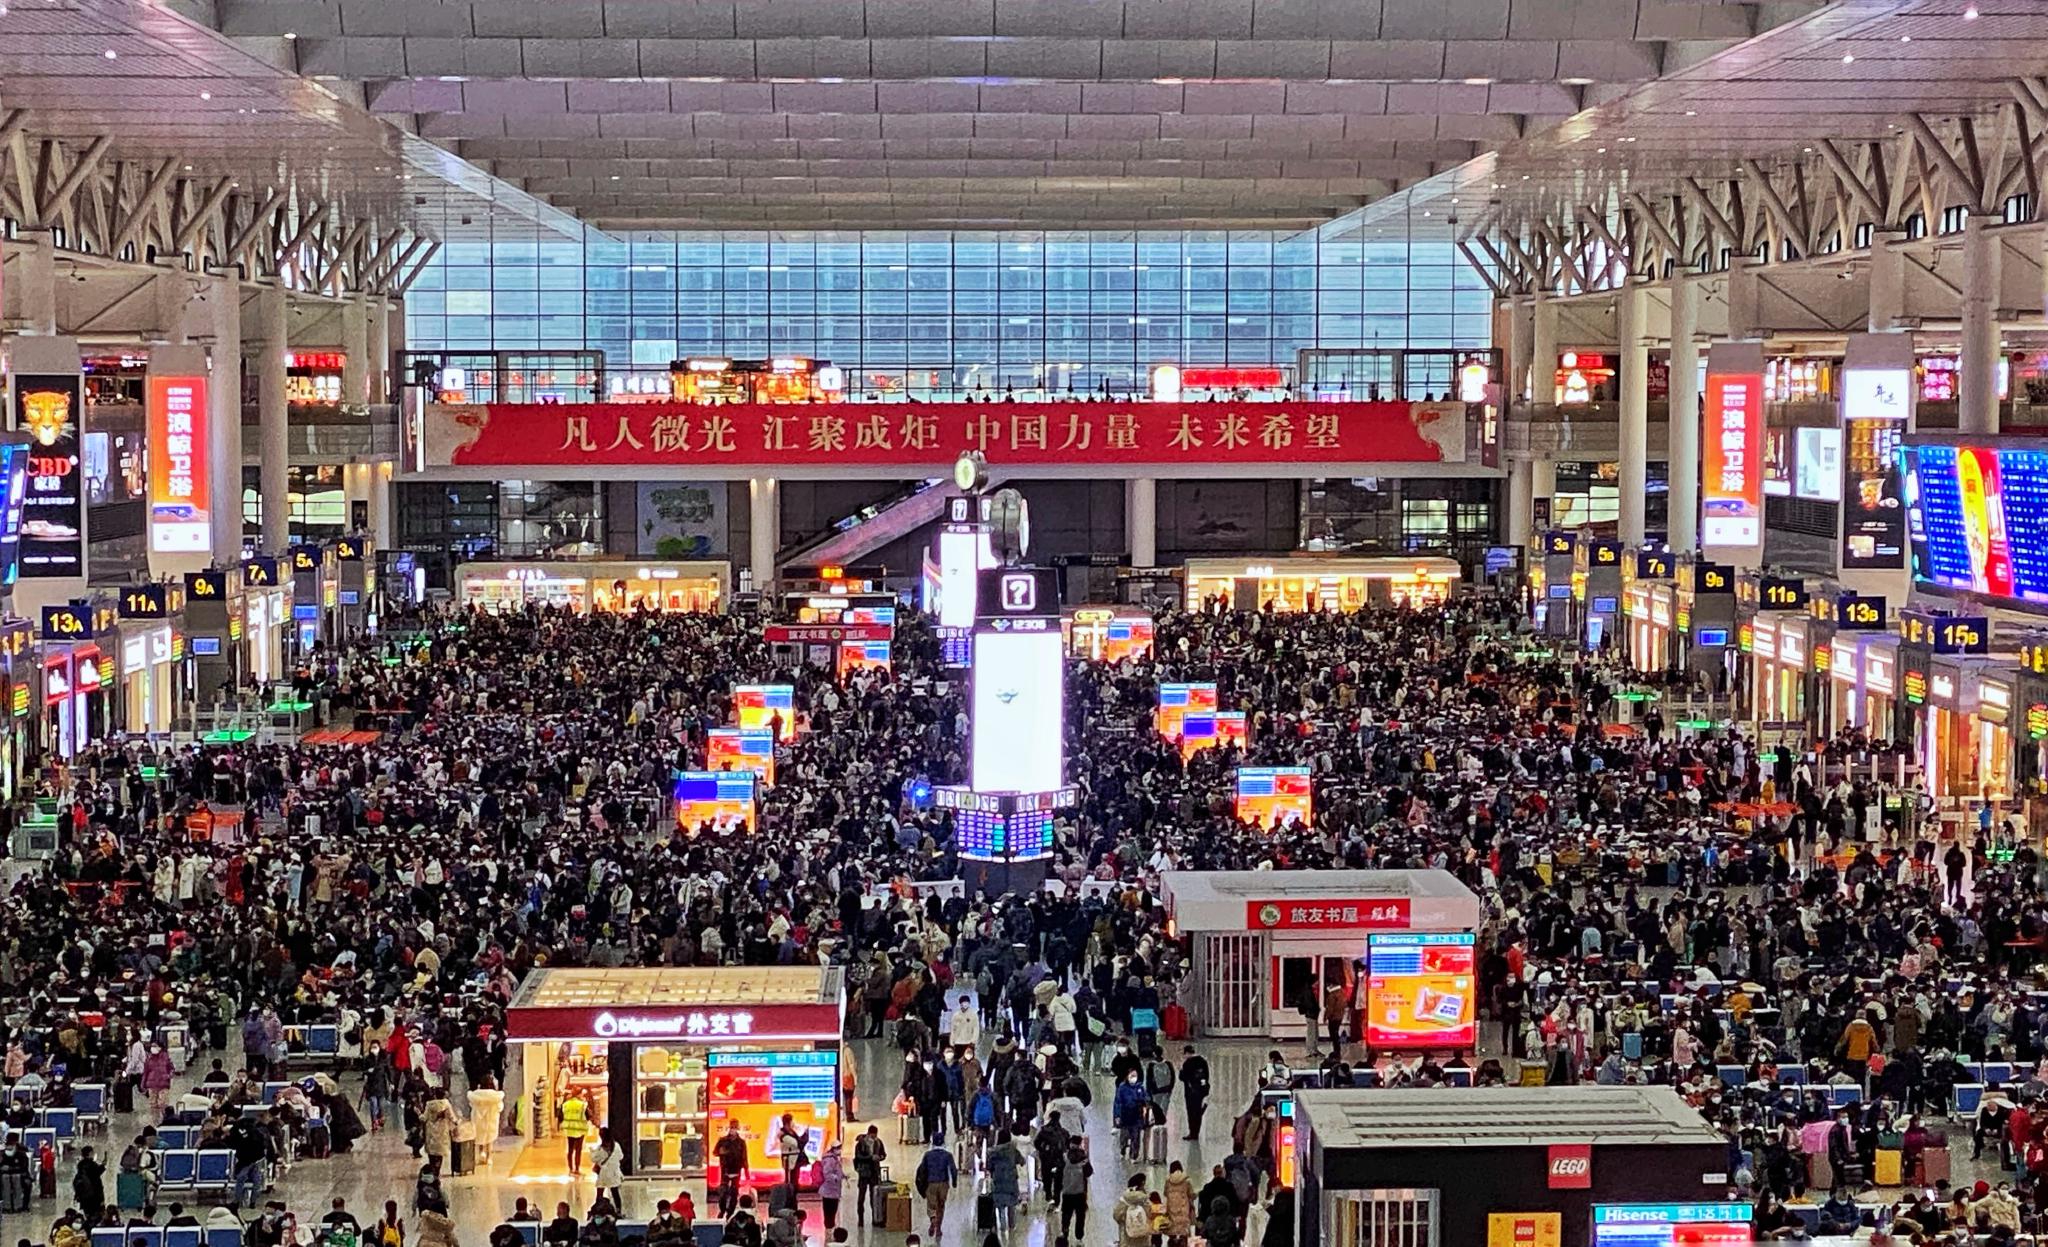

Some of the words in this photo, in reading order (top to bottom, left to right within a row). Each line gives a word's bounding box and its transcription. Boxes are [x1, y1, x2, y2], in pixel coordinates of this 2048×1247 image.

[560, 415, 737, 452] 凡人微光
[762, 414, 941, 450] 汇聚成炬
[966, 413, 1140, 450] 中国力量
[1166, 413, 1341, 449] 未来希望
[168, 413, 193, 497] 浪鲸卫浴
[1722, 410, 1746, 492] 浪鲸卫浴
[26, 458, 72, 477] CBD
[339, 543, 354, 557] 3A
[1554, 538, 1569, 551] 3B
[296, 553, 314, 568] 5A
[1598, 547, 1615, 562] 5B
[248, 565, 267, 581] 7A
[1648, 559, 1665, 574] 7B
[195, 579, 214, 595] 9A
[1705, 572, 1724, 587] 9B
[1767, 586, 1797, 602] 11B
[127, 594, 157, 612] 11A
[1846, 603, 1879, 622] 13B
[50, 613, 84, 632] 13A
[1944, 625, 1979, 645] 15B
[1291, 907, 1359, 923] 旅友书屋
[1376, 936, 1420, 944] Hisense
[687, 1012, 754, 1034] 外交官
[716, 1054, 769, 1065] Hisense
[1551, 1158, 1589, 1175] LEGO
[1604, 1208, 1669, 1221] Hisense
